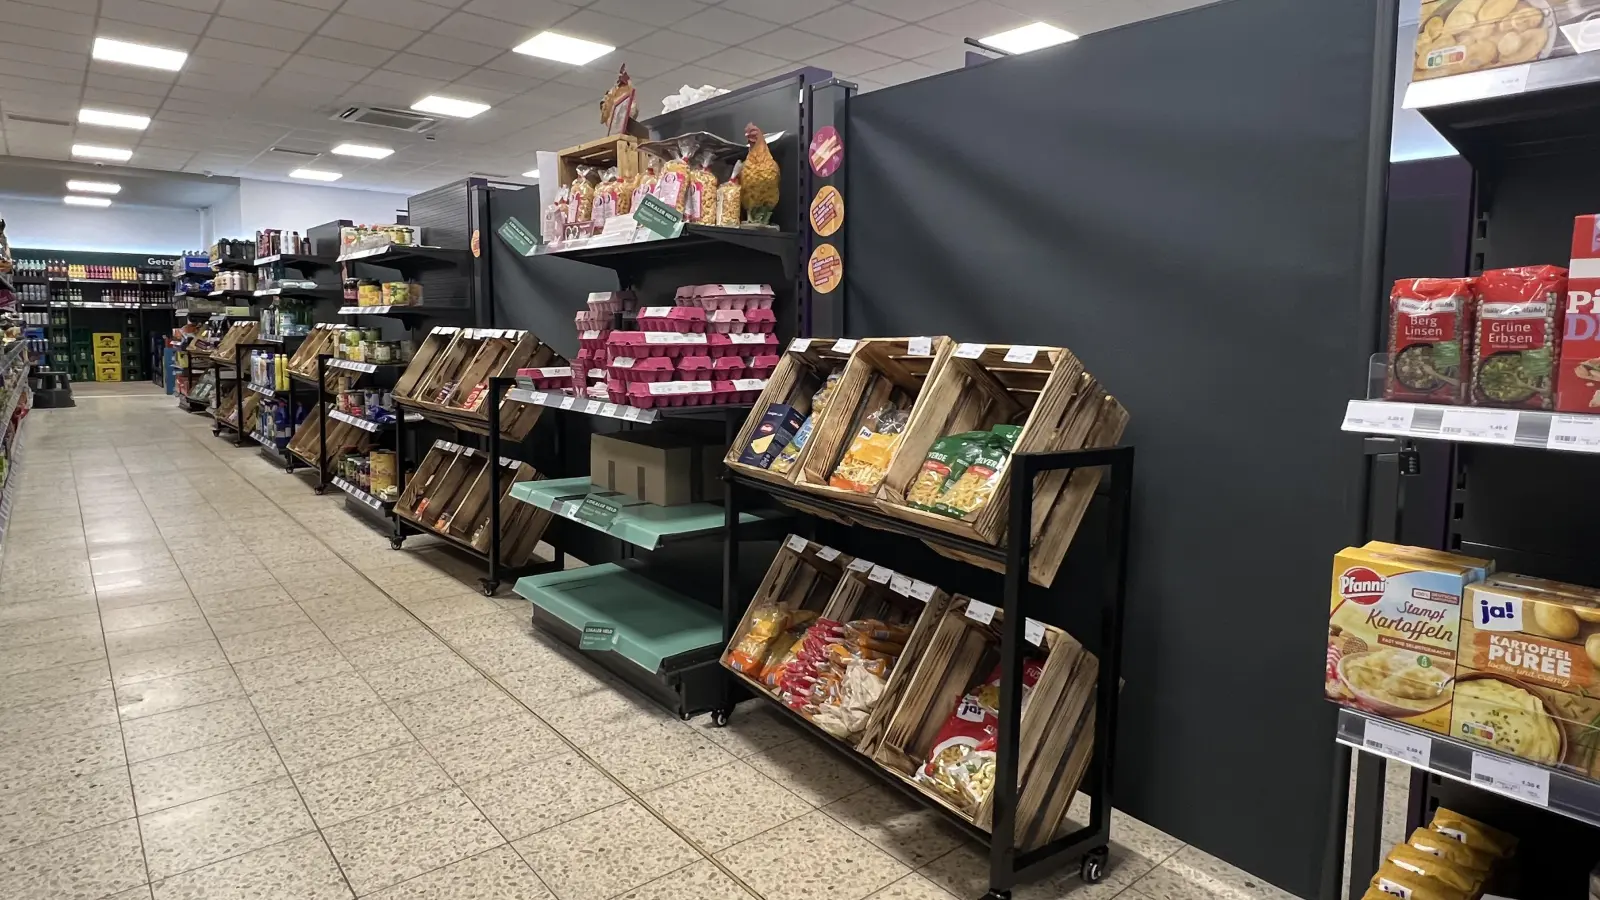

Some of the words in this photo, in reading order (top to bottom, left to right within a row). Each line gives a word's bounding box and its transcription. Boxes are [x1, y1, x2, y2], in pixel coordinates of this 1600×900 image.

[644, 200, 665, 216] LOKALER
[664, 212, 677, 222] HELD
[1405, 326, 1442, 336] Linsen
[1410, 315, 1437, 328] Berg
[1491, 321, 1531, 333] Grüne
[1488, 332, 1533, 343] Erbsen
[1340, 576, 1386, 594] Pfanni
[1397, 601, 1447, 623] Stampf
[1481, 600, 1514, 624] ja!
[1365, 608, 1453, 642] Kartoffeln
[1490, 635, 1572, 661] KARTOFFEL
[1488, 644, 1572, 678] PÜREE
